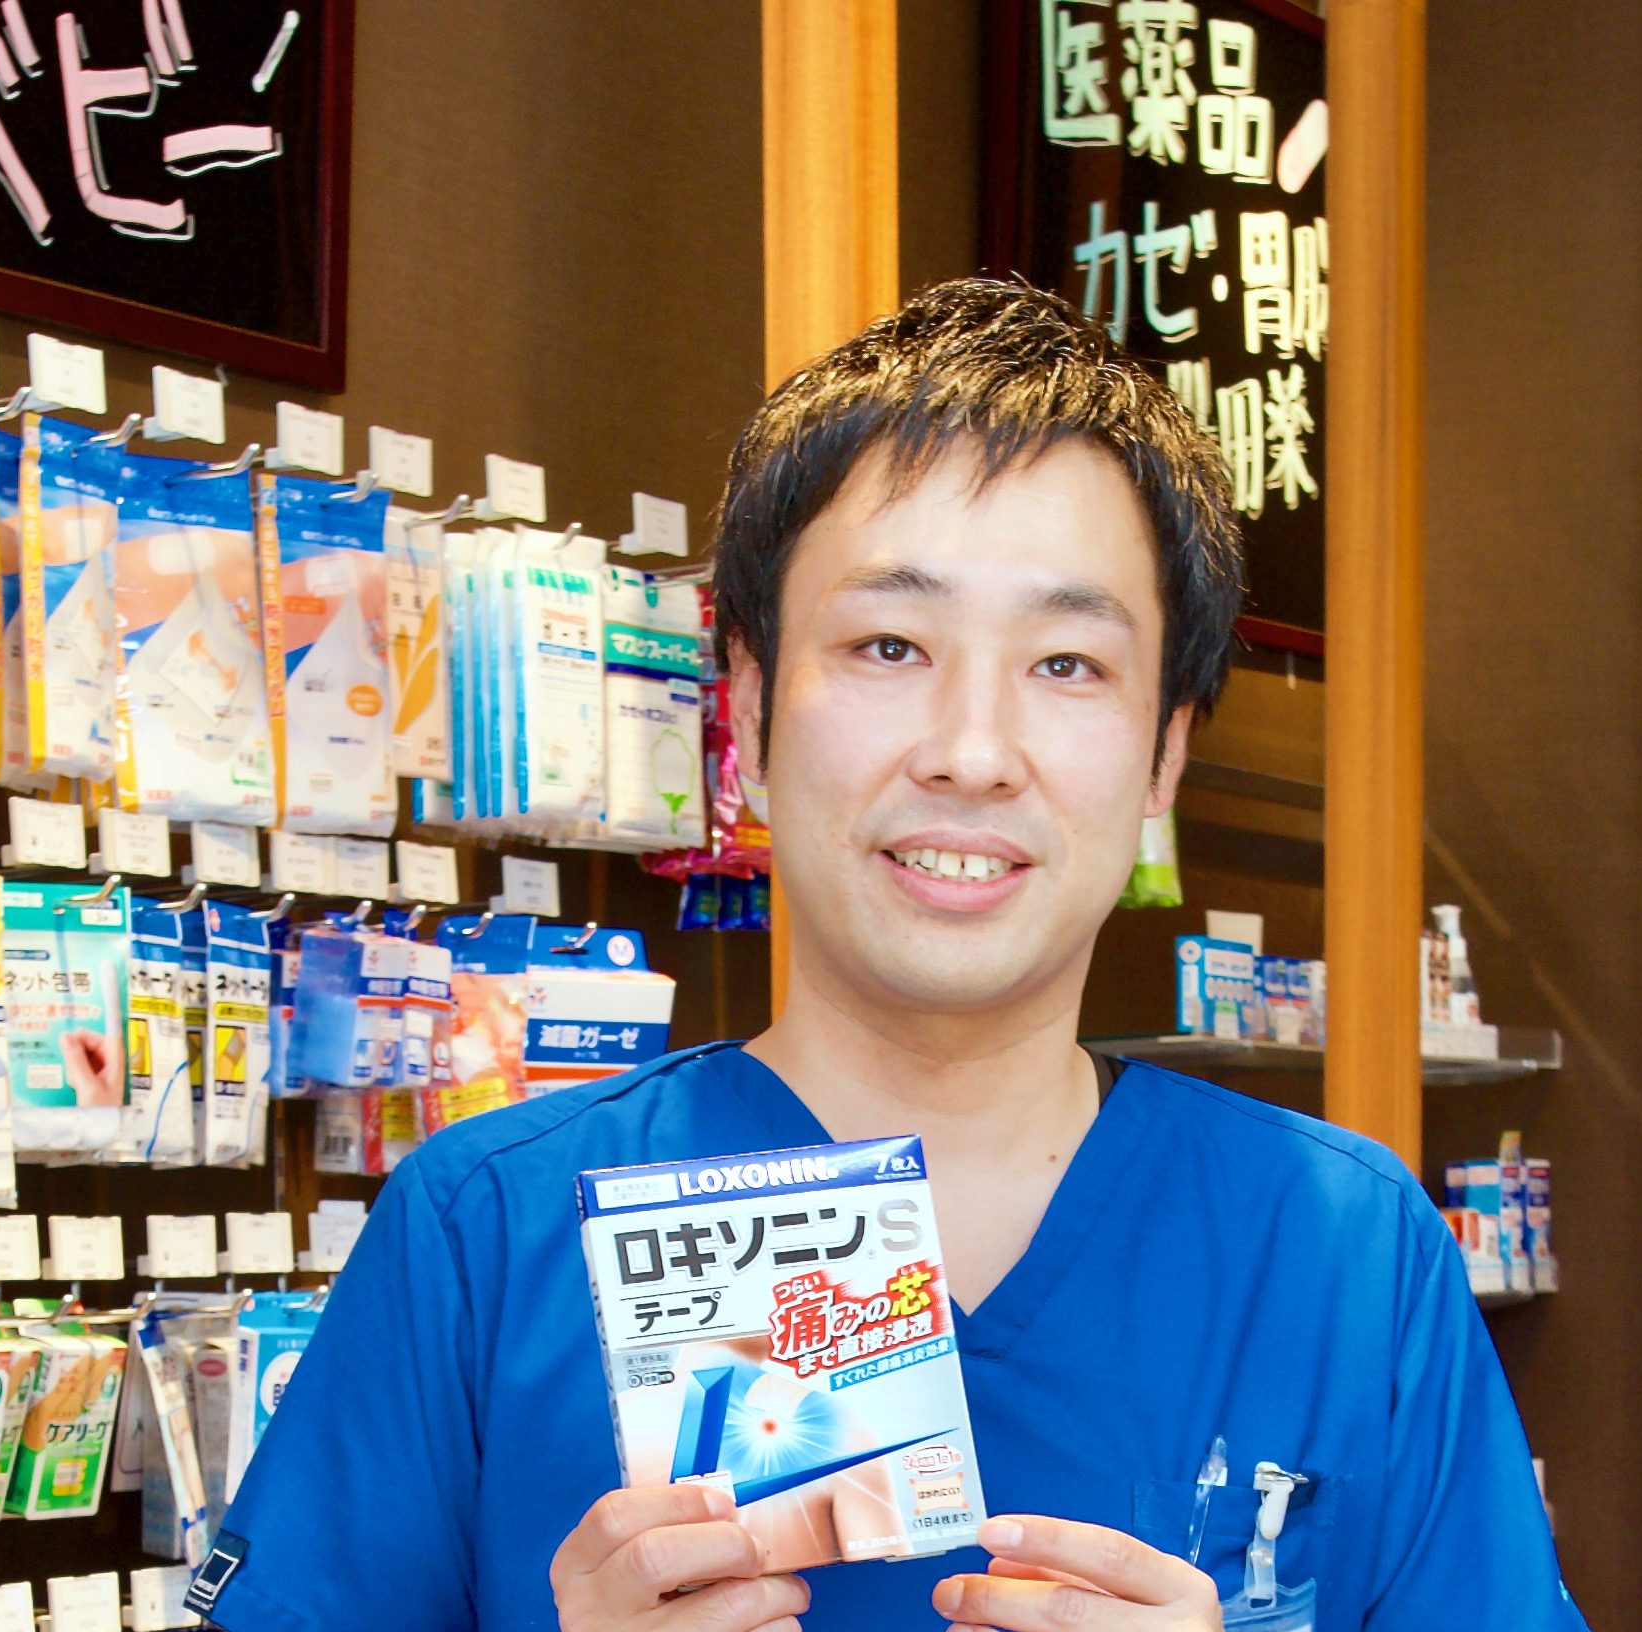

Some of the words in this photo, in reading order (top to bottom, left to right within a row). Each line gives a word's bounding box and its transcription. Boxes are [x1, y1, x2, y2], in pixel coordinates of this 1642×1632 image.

[1041, 0, 1275, 184] 医薬品
[5, 969, 92, 994] ネット包帯
[678, 1157, 829, 1198] LOXONIN
[873, 1153, 920, 1173] 7枚入
[775, 1275, 821, 1301] つらい
[634, 1290, 722, 1333] テープ
[770, 1269, 933, 1361] 痛みの芯
[796, 1310, 934, 1377] まで直接浸透
[46, 1419, 111, 1443] ケアリーヴ
